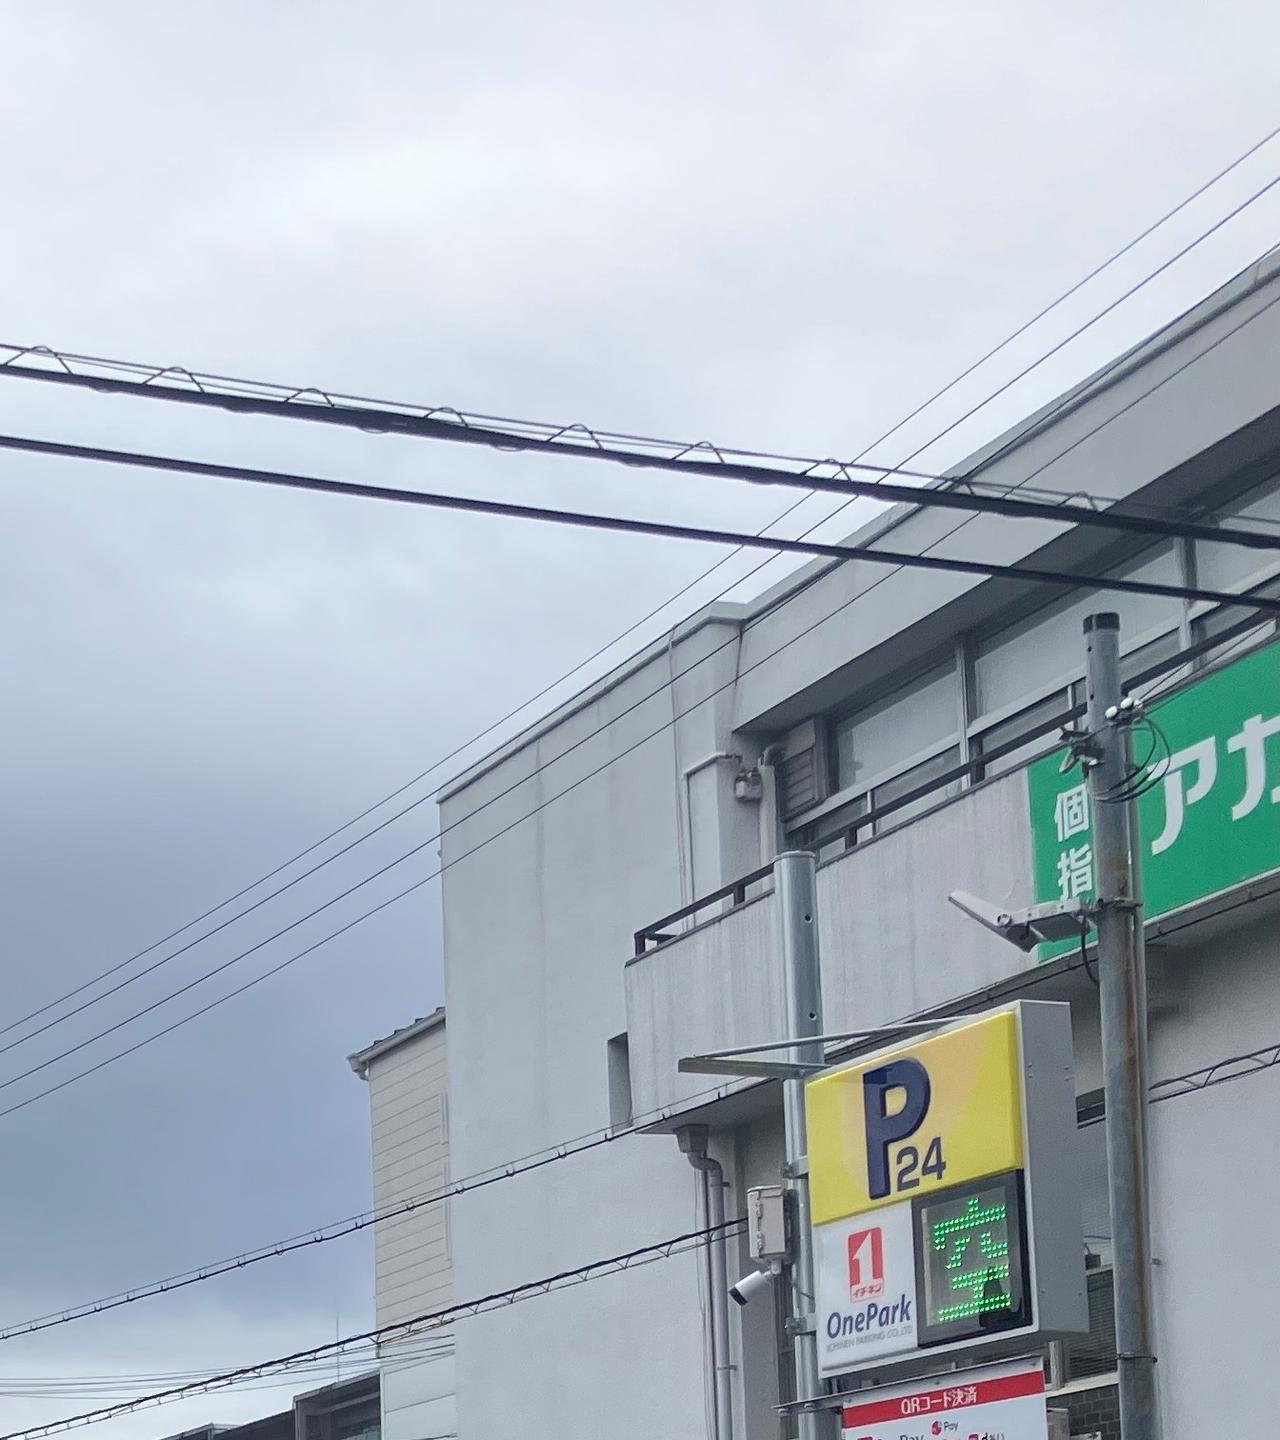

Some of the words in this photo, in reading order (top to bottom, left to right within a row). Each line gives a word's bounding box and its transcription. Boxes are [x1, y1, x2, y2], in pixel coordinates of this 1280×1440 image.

[862, 1057, 931, 1200] P
[896, 1137, 947, 1193] 24
[934, 1198, 1012, 1322] 空
[827, 1295, 912, 1339] OnePark
[901, 1386, 977, 1415] QRコード決済
